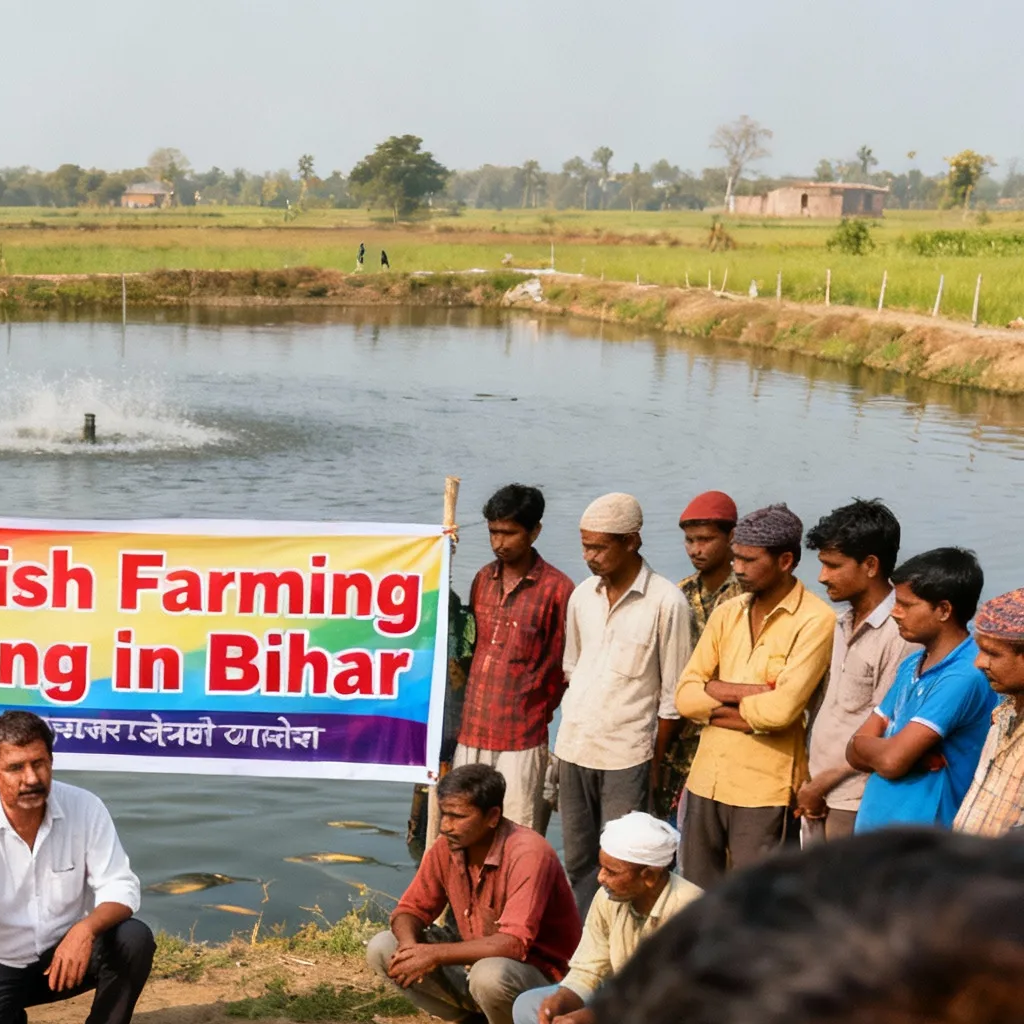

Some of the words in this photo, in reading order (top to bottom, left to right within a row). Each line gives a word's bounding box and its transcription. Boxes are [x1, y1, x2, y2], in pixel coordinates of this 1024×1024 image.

[120, 554, 421, 636] Farming
[114, 628, 181, 691] in
[207, 632, 411, 697] Bihar
